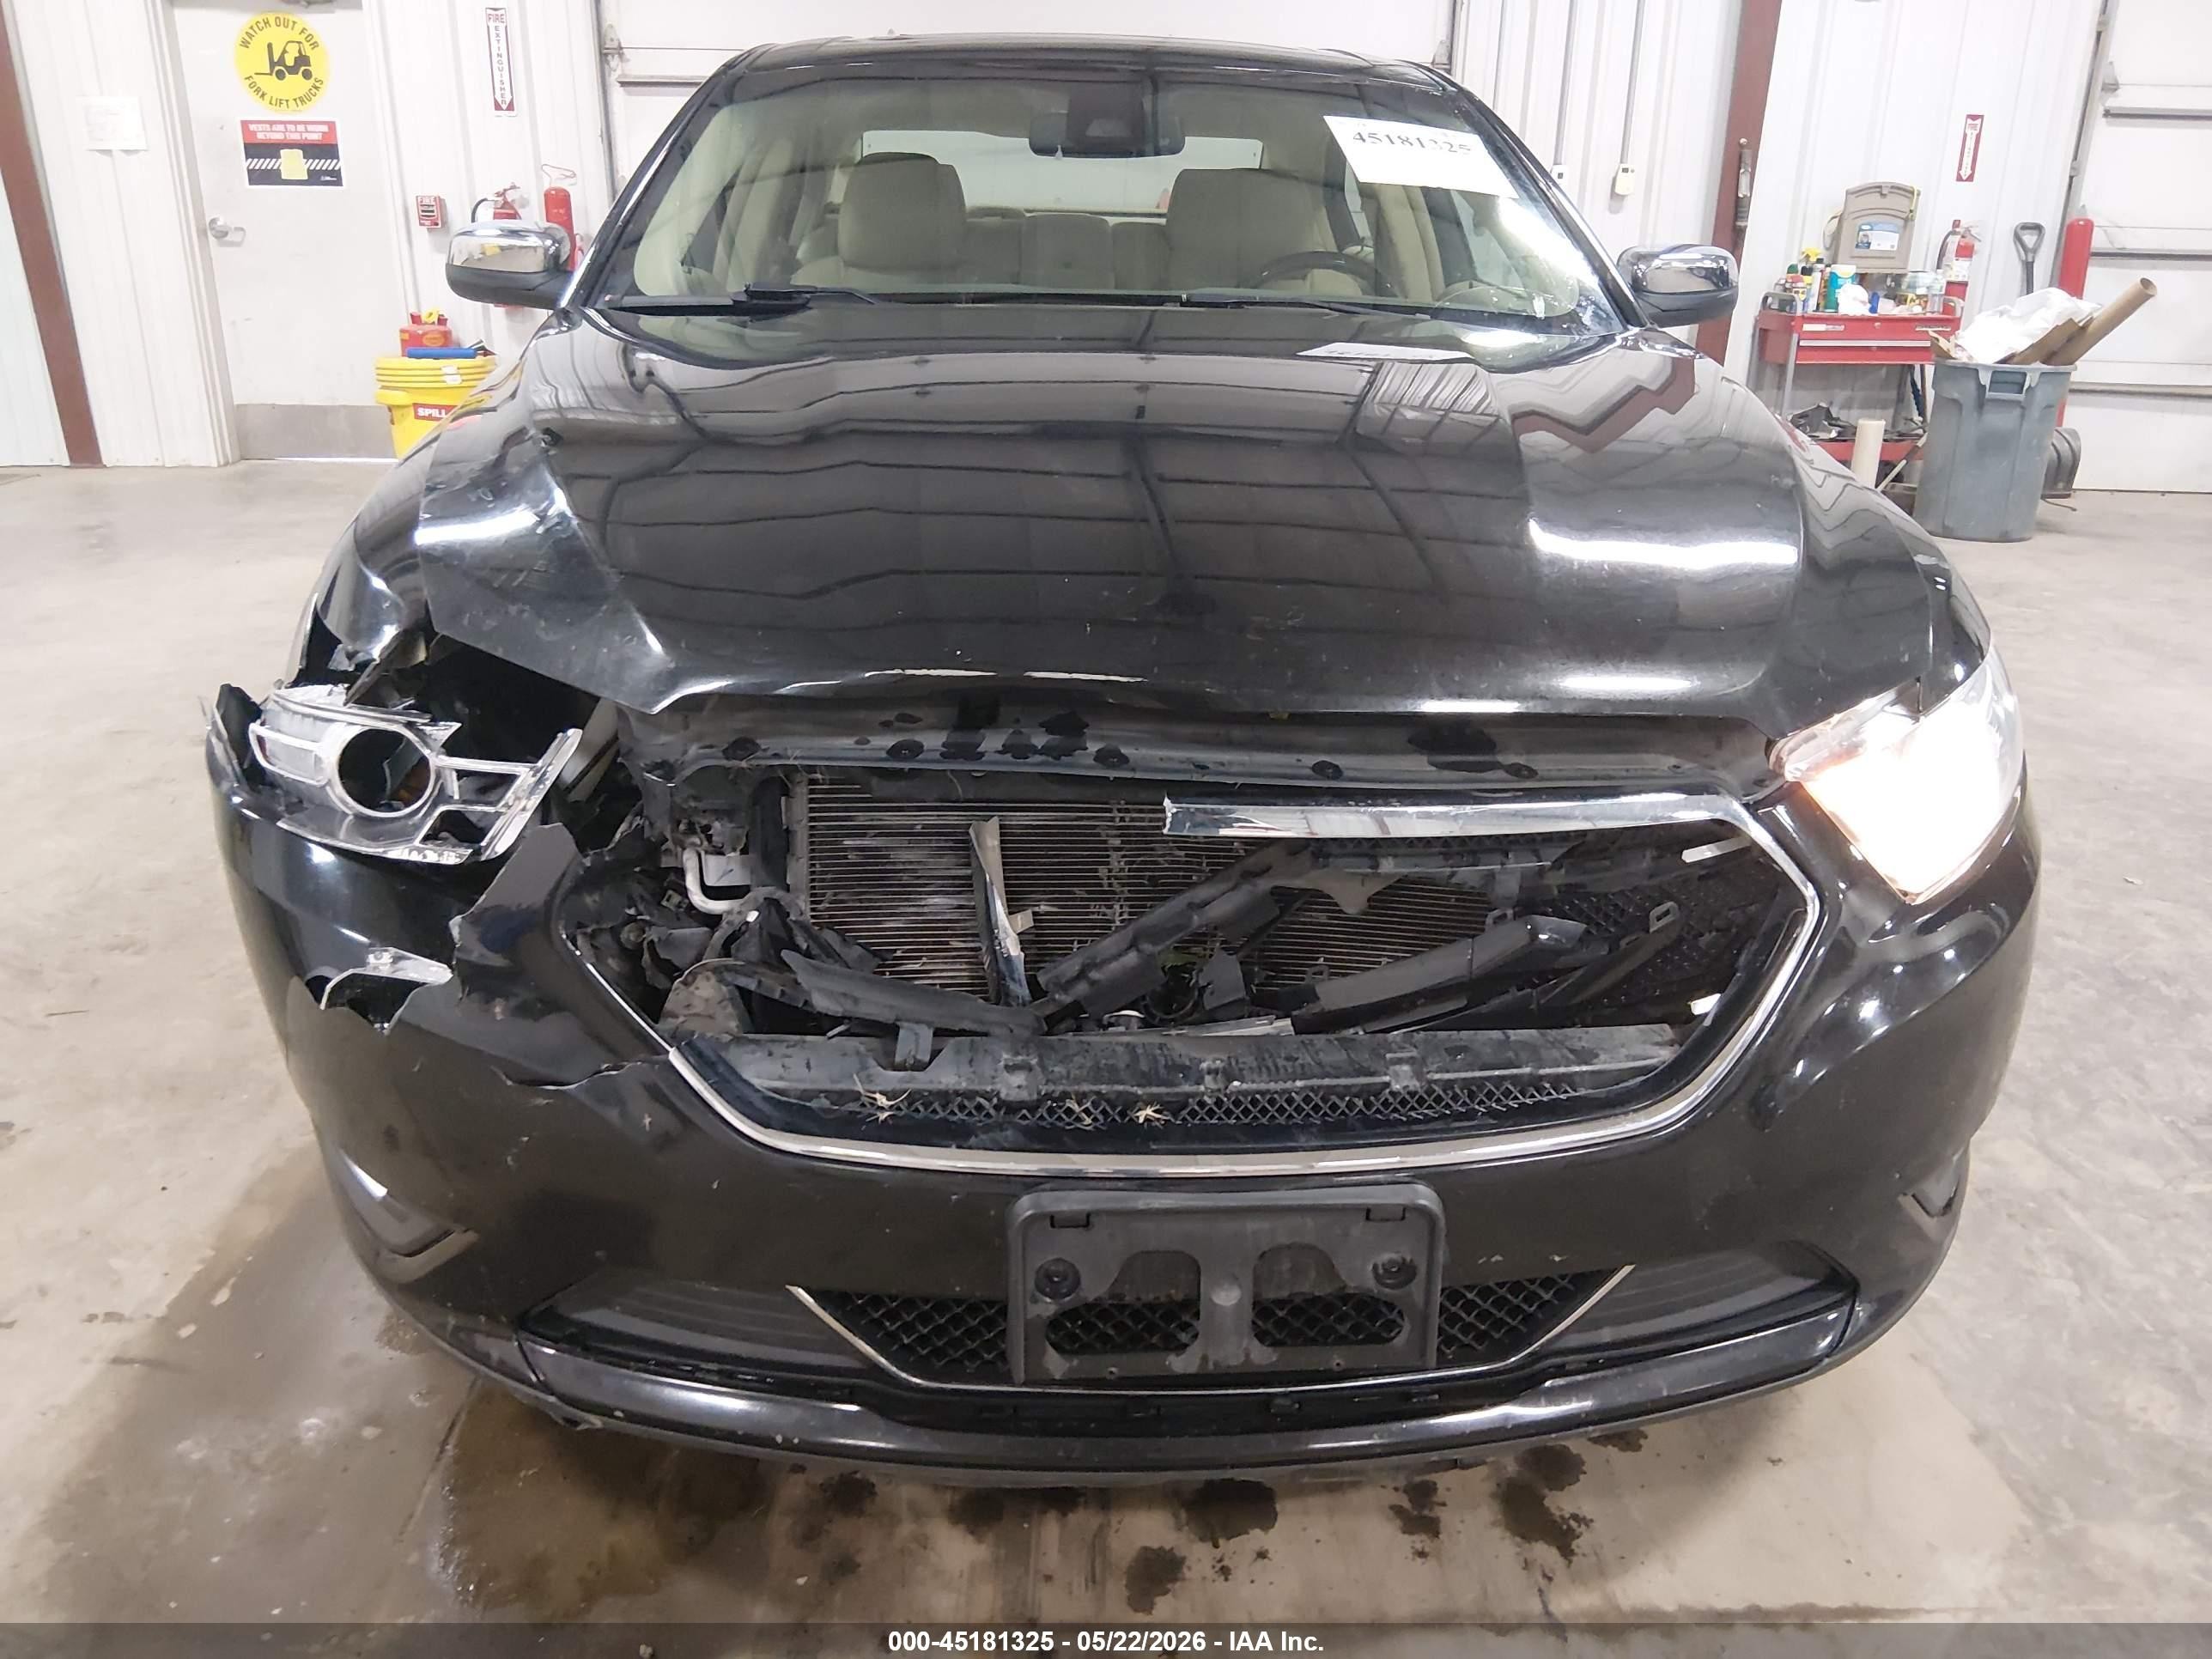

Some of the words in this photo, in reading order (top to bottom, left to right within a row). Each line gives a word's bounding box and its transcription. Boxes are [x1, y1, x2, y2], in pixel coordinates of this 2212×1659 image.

[240, 17, 272, 49] WATCH
[274, 15, 298, 31] OUT
[299, 27, 319, 51] FOR
[487, 13, 506, 24] FIRE
[494, 25, 507, 106] EXTINGUISHER
[244, 75, 268, 101] FORK
[269, 95, 290, 109] LIFT
[292, 77, 324, 108] TRUCKS
[416, 407, 447, 417] SPILL
